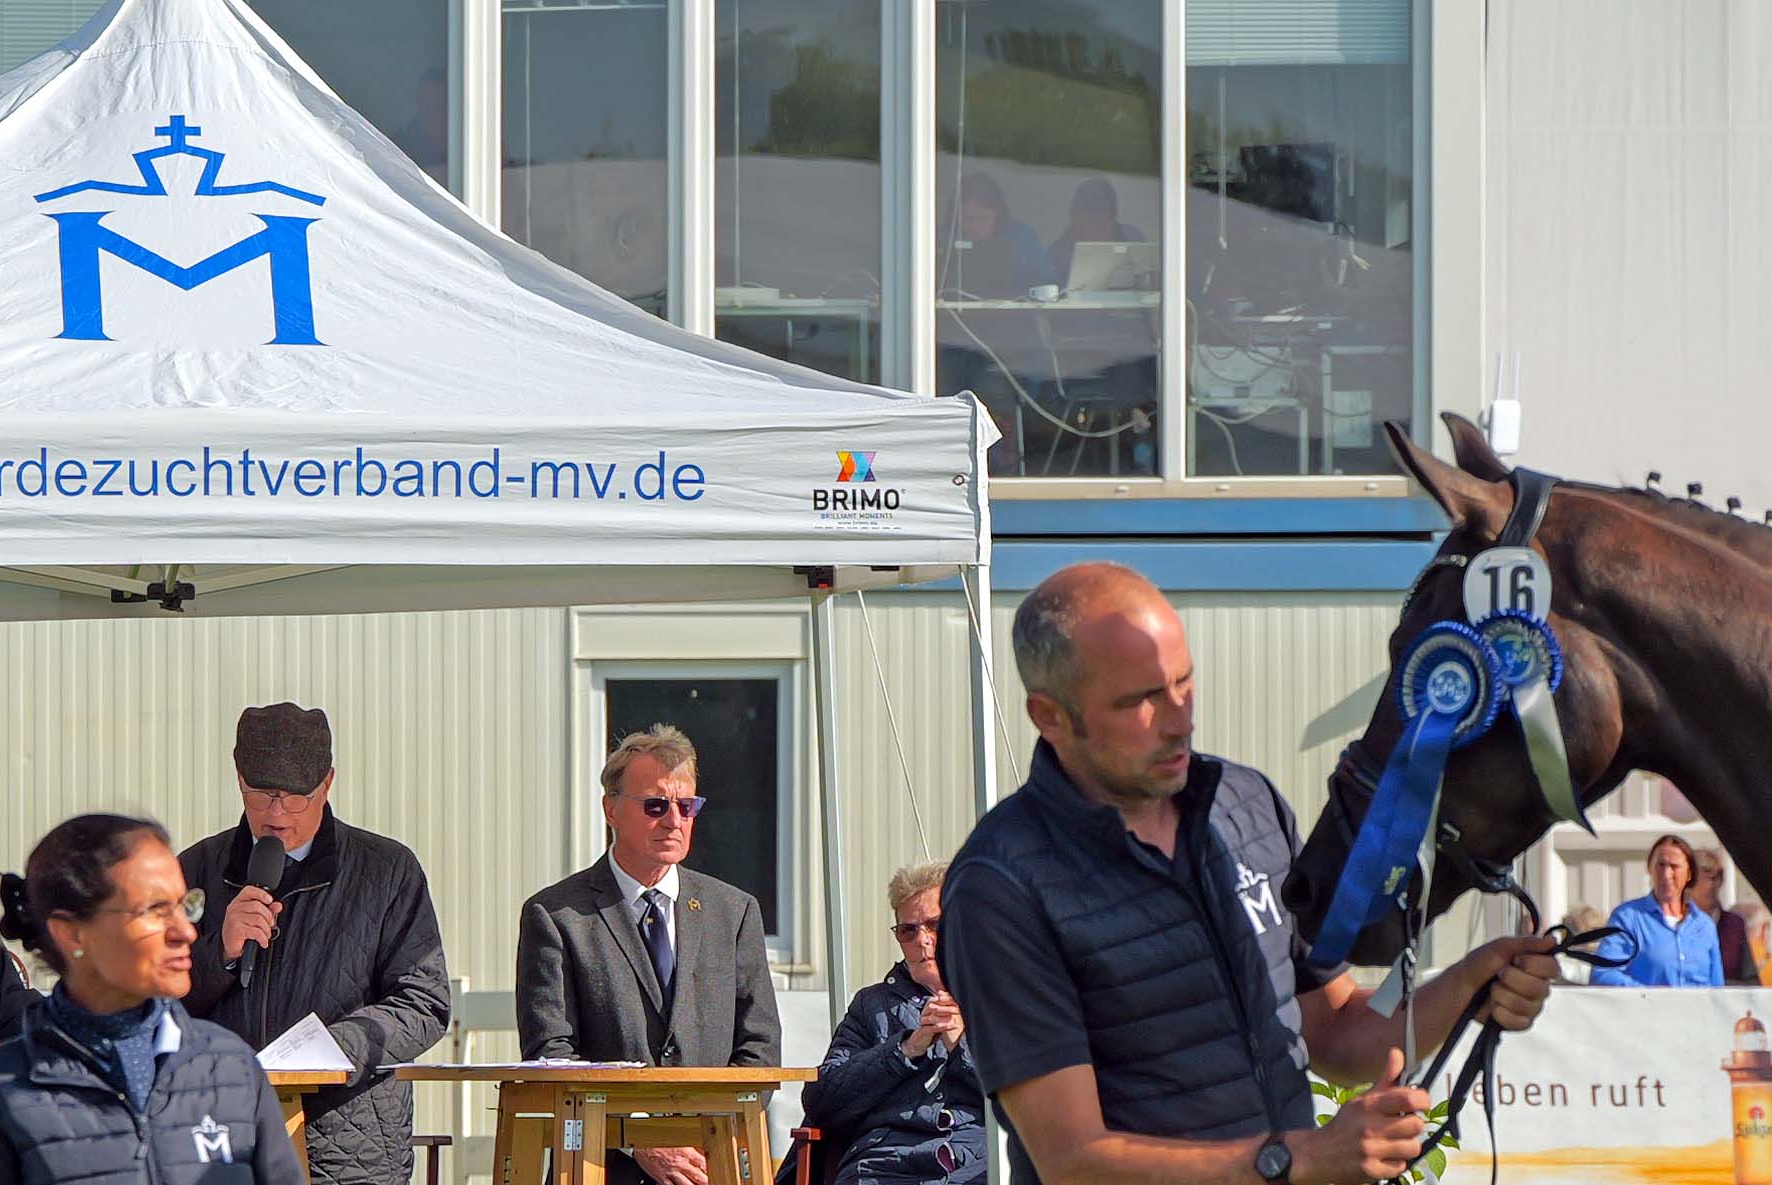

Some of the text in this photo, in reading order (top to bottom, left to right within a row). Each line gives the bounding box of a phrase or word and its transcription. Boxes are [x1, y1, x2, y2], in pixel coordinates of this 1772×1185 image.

[39, 210, 330, 346] M
[813, 489, 900, 510] BRIMO
[1484, 566, 1534, 613] 16
[1591, 1075, 1666, 1107] ruft
